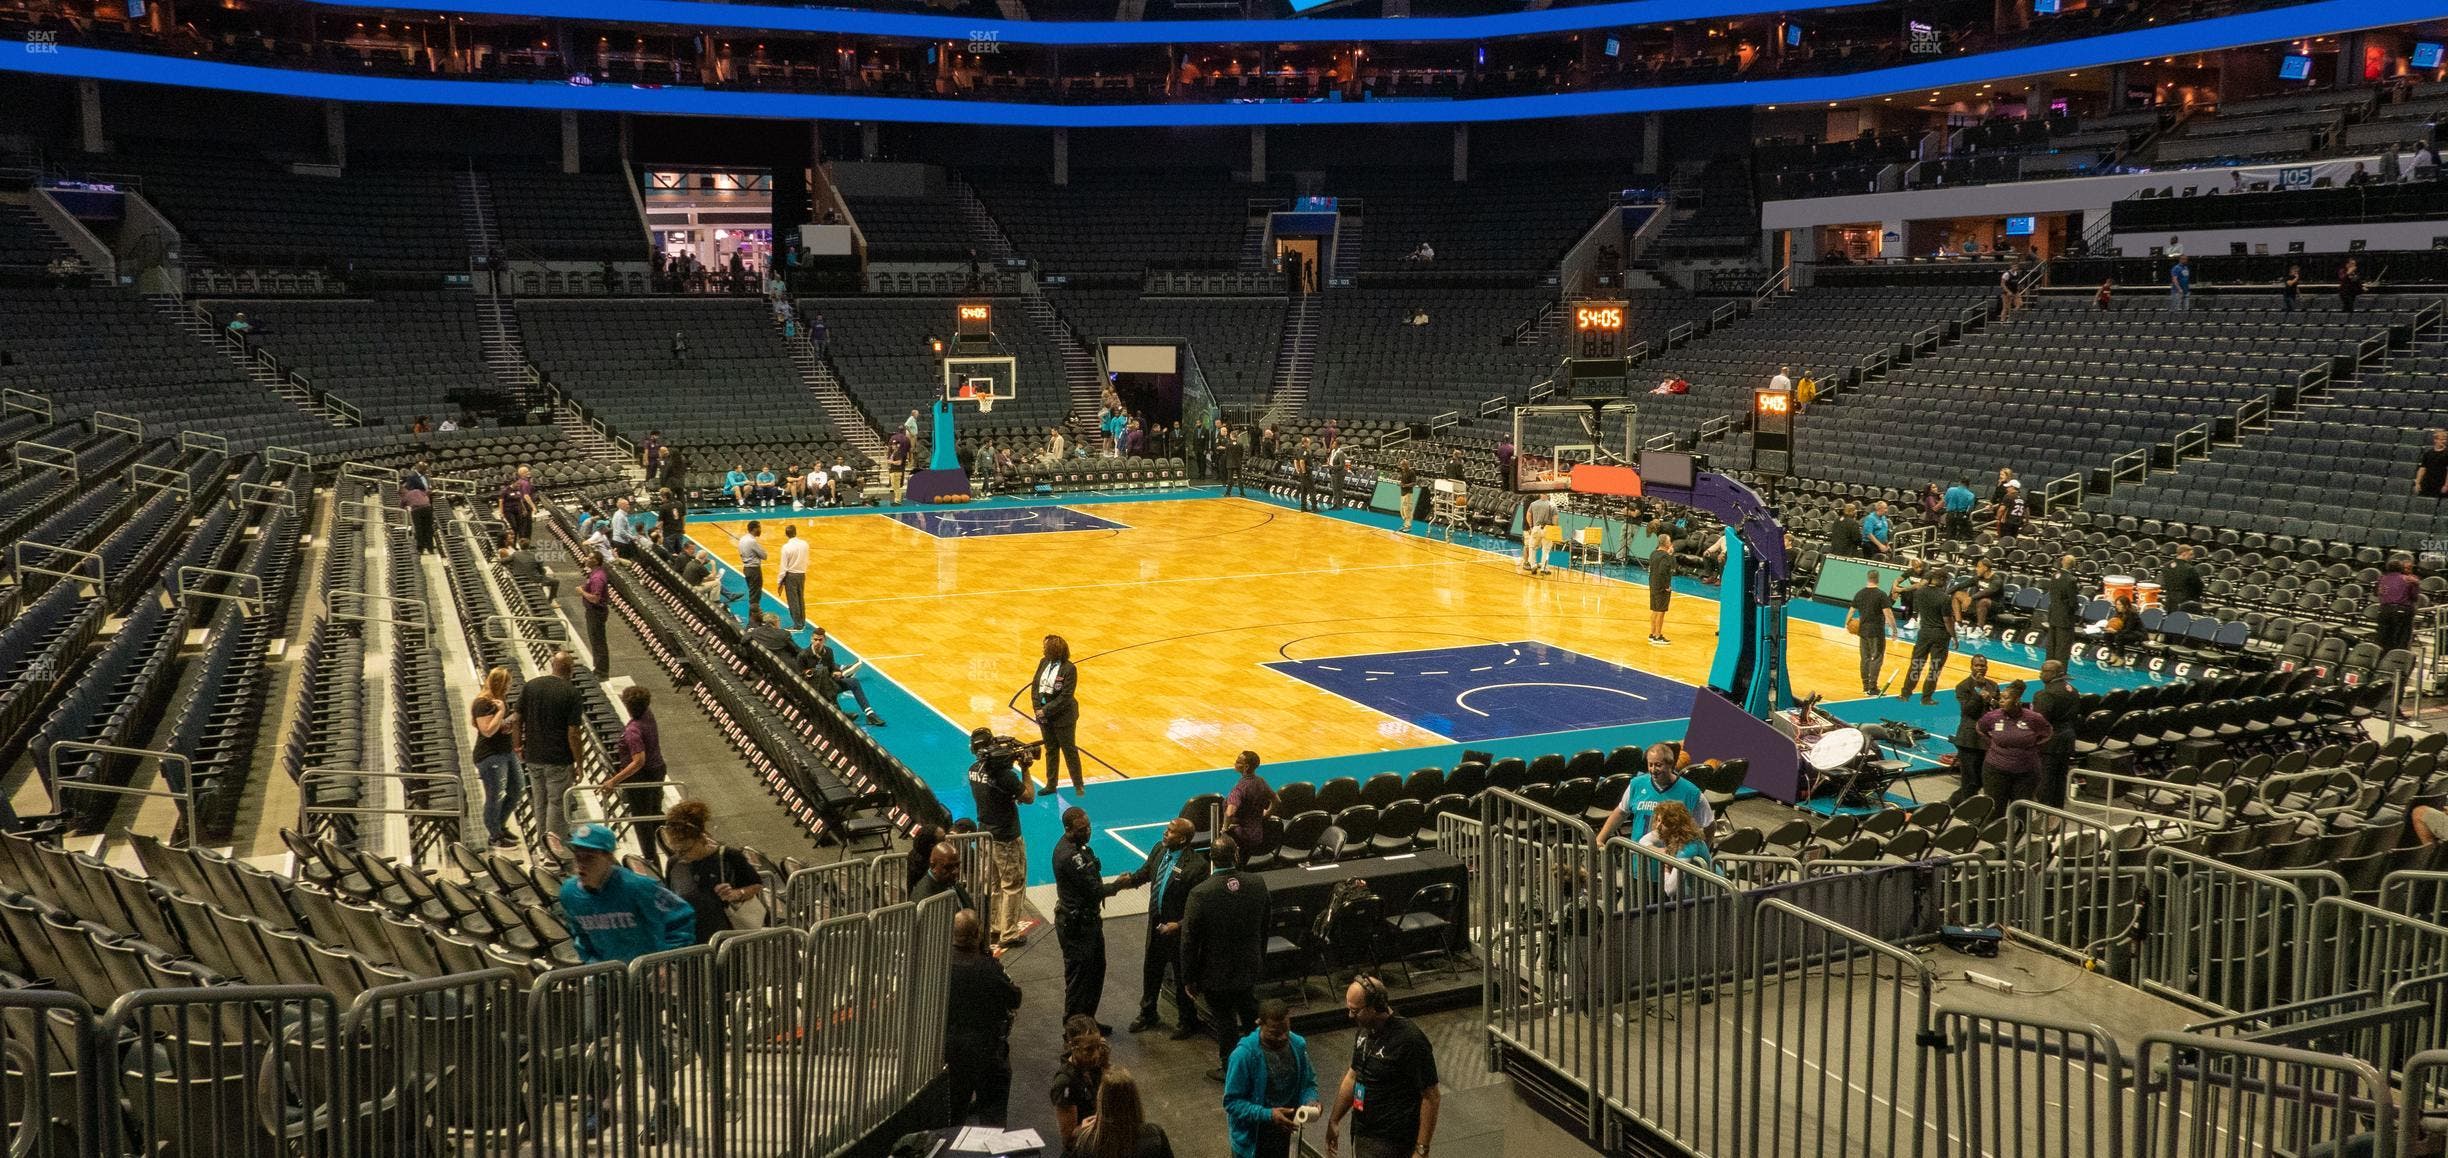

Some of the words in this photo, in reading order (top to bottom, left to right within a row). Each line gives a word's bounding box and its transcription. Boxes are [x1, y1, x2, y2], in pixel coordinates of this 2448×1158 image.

[2282, 169, 2310, 185] 105
[1579, 309, 1620, 328] 54:05
[2001, 629, 2016, 641] G
[2024, 632, 2039, 645] G
[2070, 643, 2085, 656] G
[2096, 647, 2110, 660] G
[2149, 658, 2164, 670] G
[2175, 662, 2192, 676] G
[968, 770, 988, 783] HIVE
